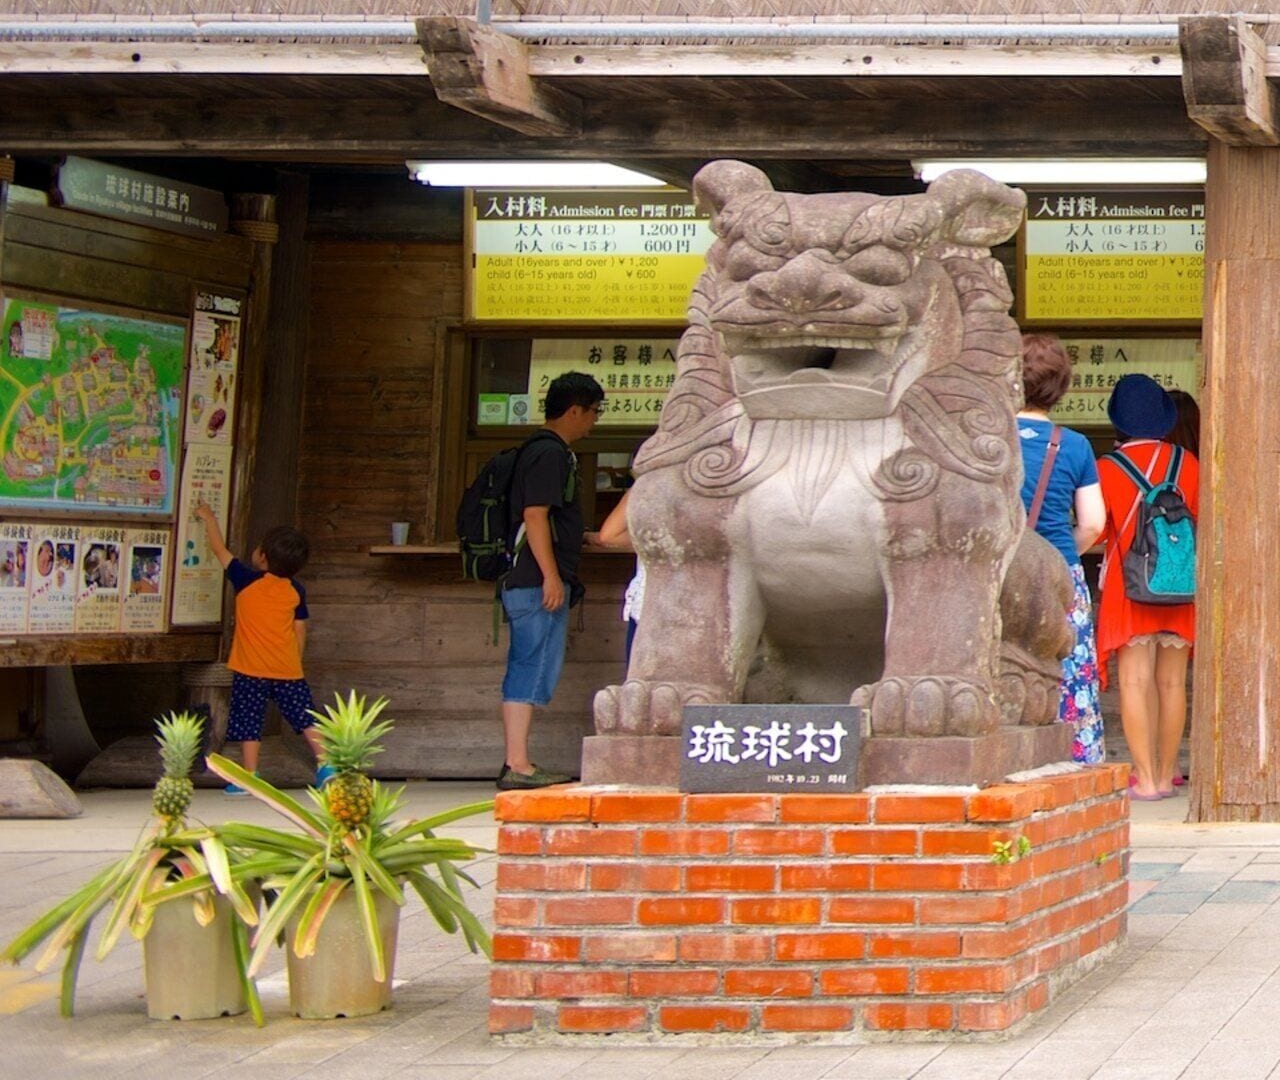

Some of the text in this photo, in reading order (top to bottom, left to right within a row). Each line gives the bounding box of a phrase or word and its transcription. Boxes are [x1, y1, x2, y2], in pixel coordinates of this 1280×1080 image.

[484, 197, 547, 217] 入村料
[549, 205, 615, 217] Admission
[619, 204, 638, 217] fee
[1035, 197, 1097, 217] 入村料
[1100, 205, 1164, 217] Admission
[1169, 204, 1189, 217] fee
[514, 223, 544, 237] 大人
[1065, 223, 1094, 237] 大人
[514, 240, 544, 253] 小人
[1065, 240, 1094, 253] 小人
[487, 257, 513, 267] Adult
[563, 257, 584, 267] and
[586, 259, 607, 267] over
[1038, 257, 1064, 267] Adult
[1114, 257, 1135, 267] and
[1137, 259, 1158, 267] over
[487, 269, 511, 280] child
[546, 270, 574, 281] years
[1038, 270, 1062, 280] child
[1098, 271, 1125, 281] years
[588, 344, 677, 366] お客様へ
[688, 720, 848, 767] 琉球村
